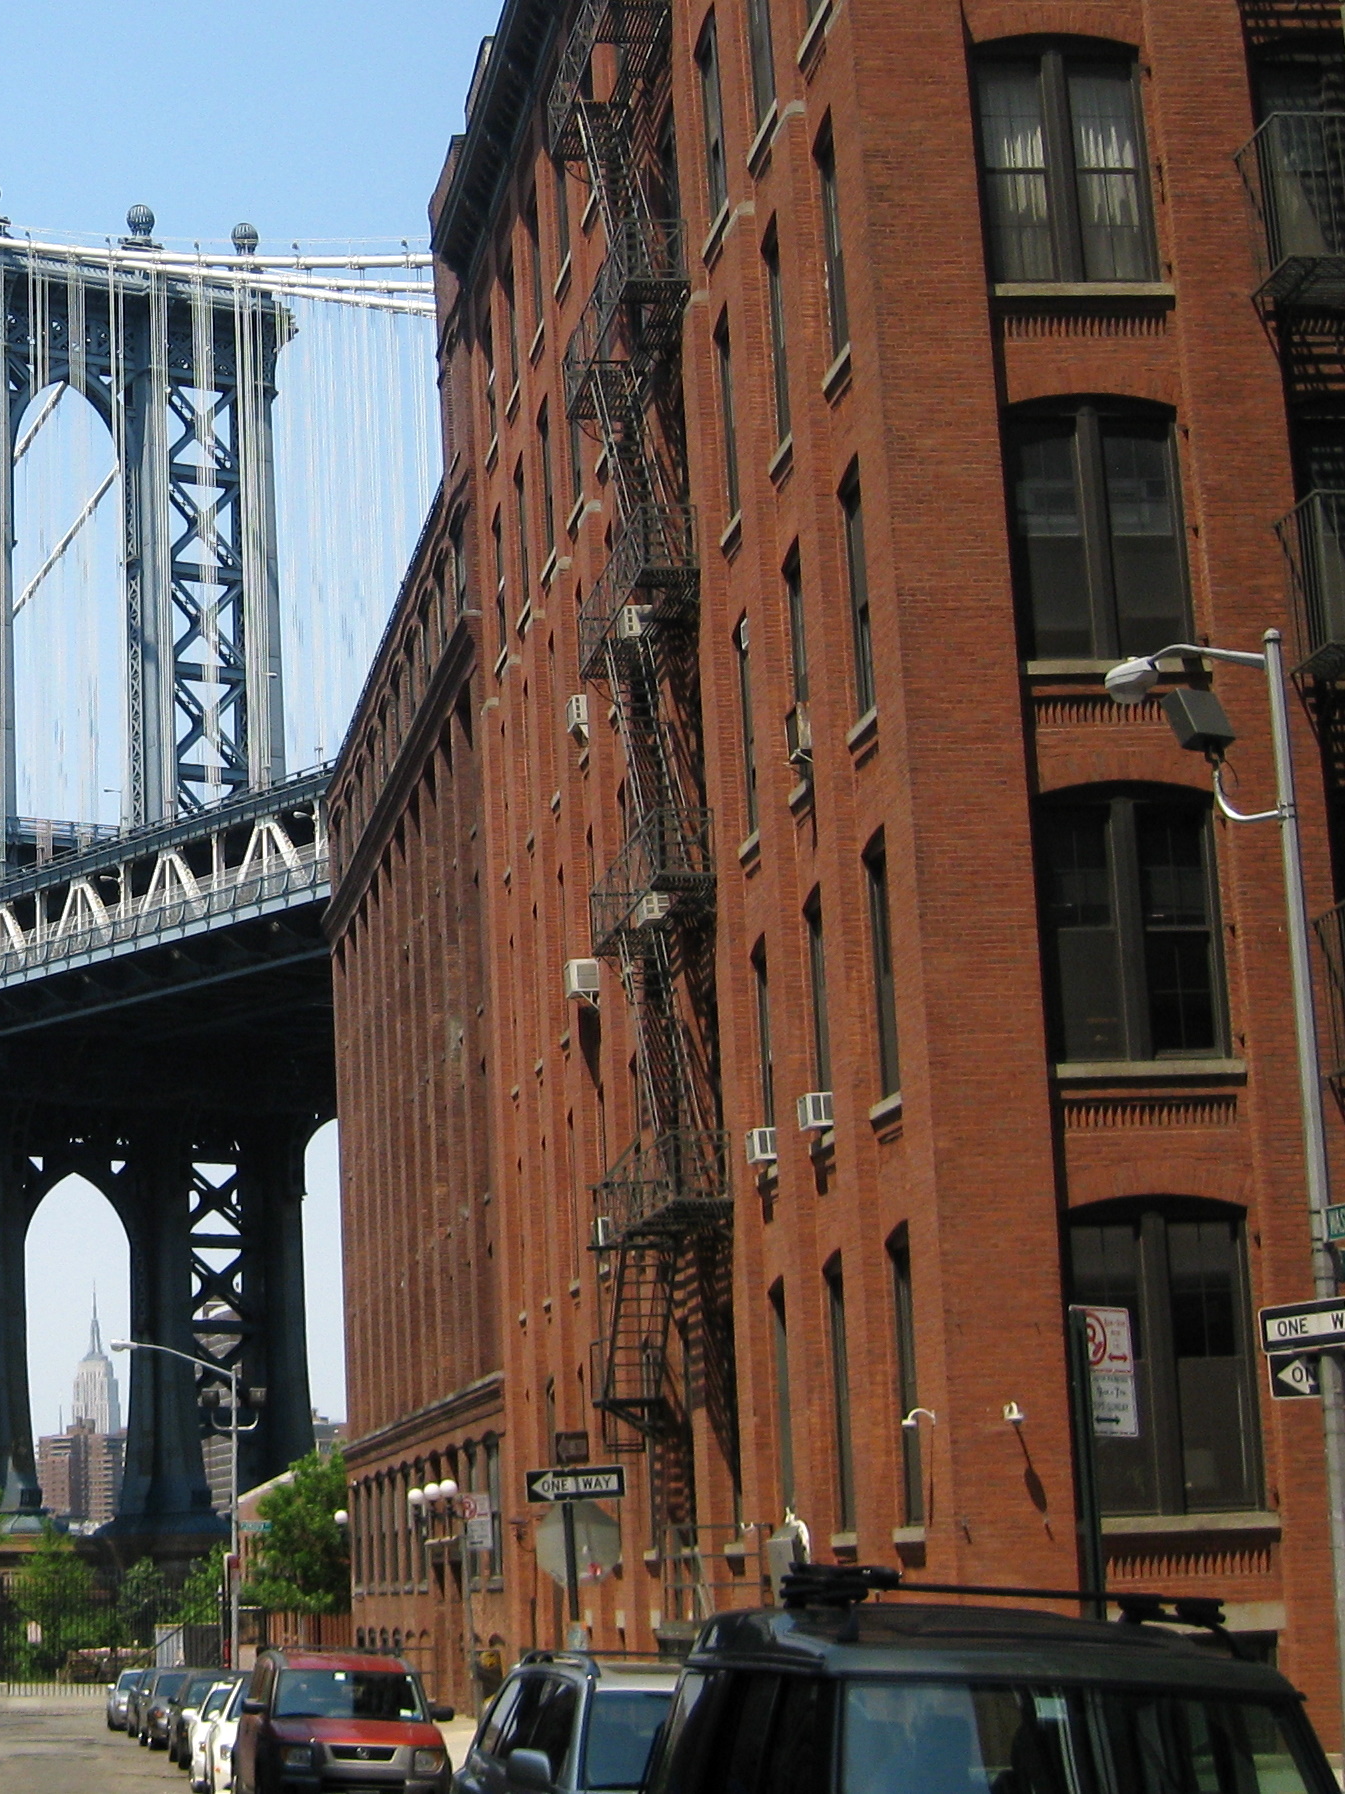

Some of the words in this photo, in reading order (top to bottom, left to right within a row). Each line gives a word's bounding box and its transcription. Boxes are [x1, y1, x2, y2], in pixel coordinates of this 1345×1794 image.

[1277, 1317, 1309, 1336] ONE
[541, 1479, 569, 1493] ONE
[582, 1476, 612, 1490] WAY
